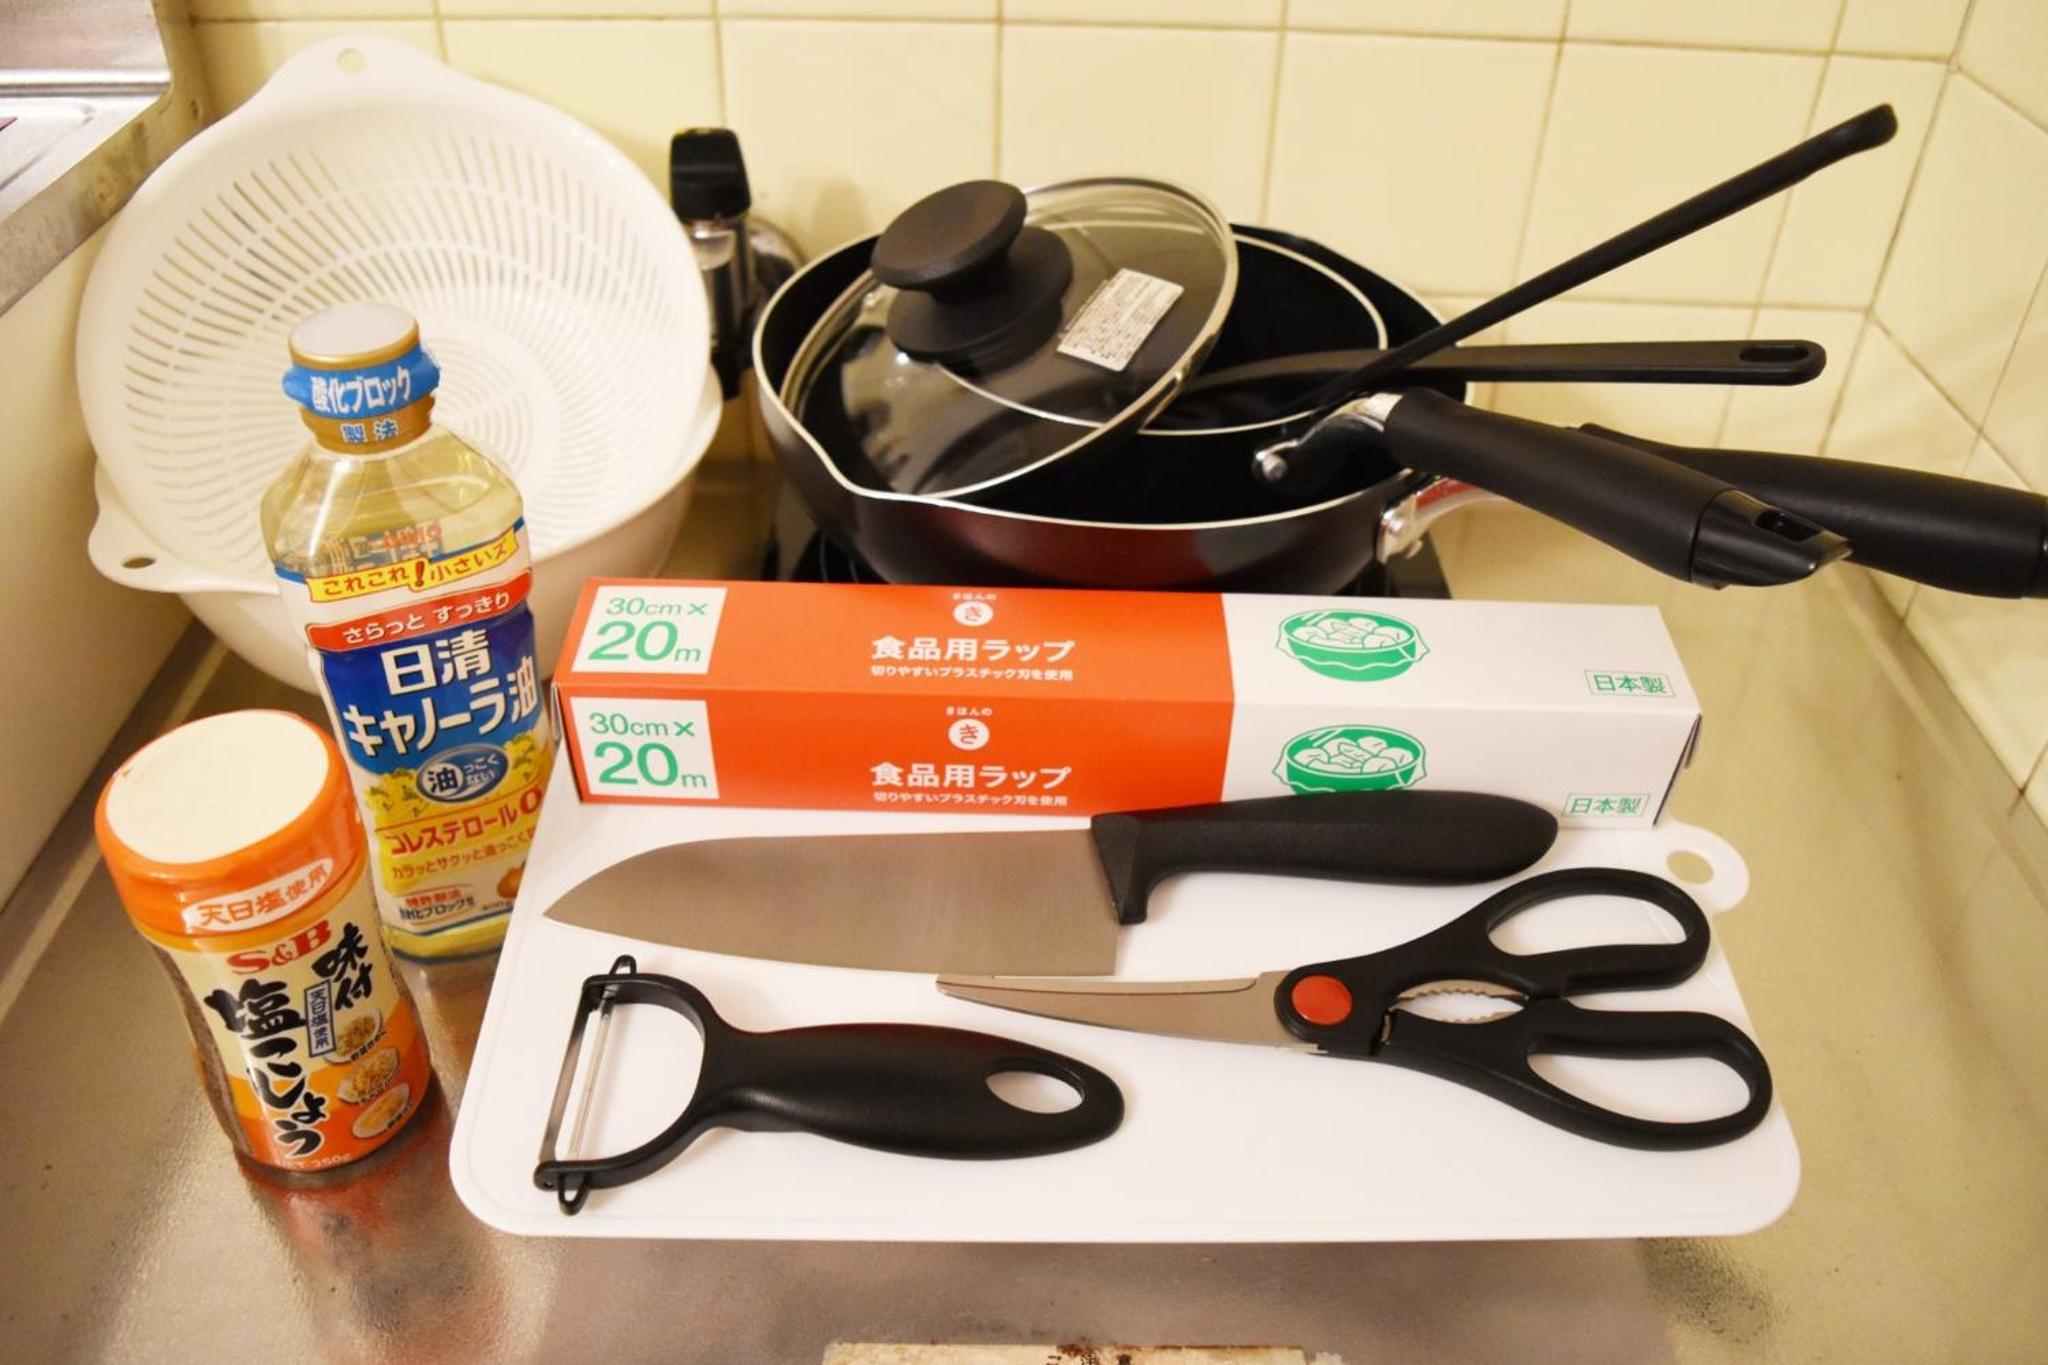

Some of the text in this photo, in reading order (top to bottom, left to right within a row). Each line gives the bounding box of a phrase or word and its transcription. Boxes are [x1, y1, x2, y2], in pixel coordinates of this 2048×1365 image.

[310, 366, 411, 413] 酸化ブロック
[341, 419, 399, 443] 製法
[343, 591, 510, 644] さらっと すっきり
[380, 628, 493, 696] 日清
[871, 635, 1076, 663] 食品用ラップ
[870, 664, 1074, 682] 切りやすいプラスチック刃を使用
[1594, 674, 1666, 693] 日本製
[342, 655, 537, 757] キャノーラ油
[427, 766, 459, 793] 油
[870, 761, 1073, 790] 食品用ラップ
[873, 791, 1069, 807] 切りやすいプラスチック刃を使用
[1570, 797, 1642, 814] 日本製
[197, 864, 327, 926] 天日塩使用
[227, 920, 331, 974] S&B
[312, 922, 372, 1010] 味付
[203, 978, 326, 1156] 塩こしょう
